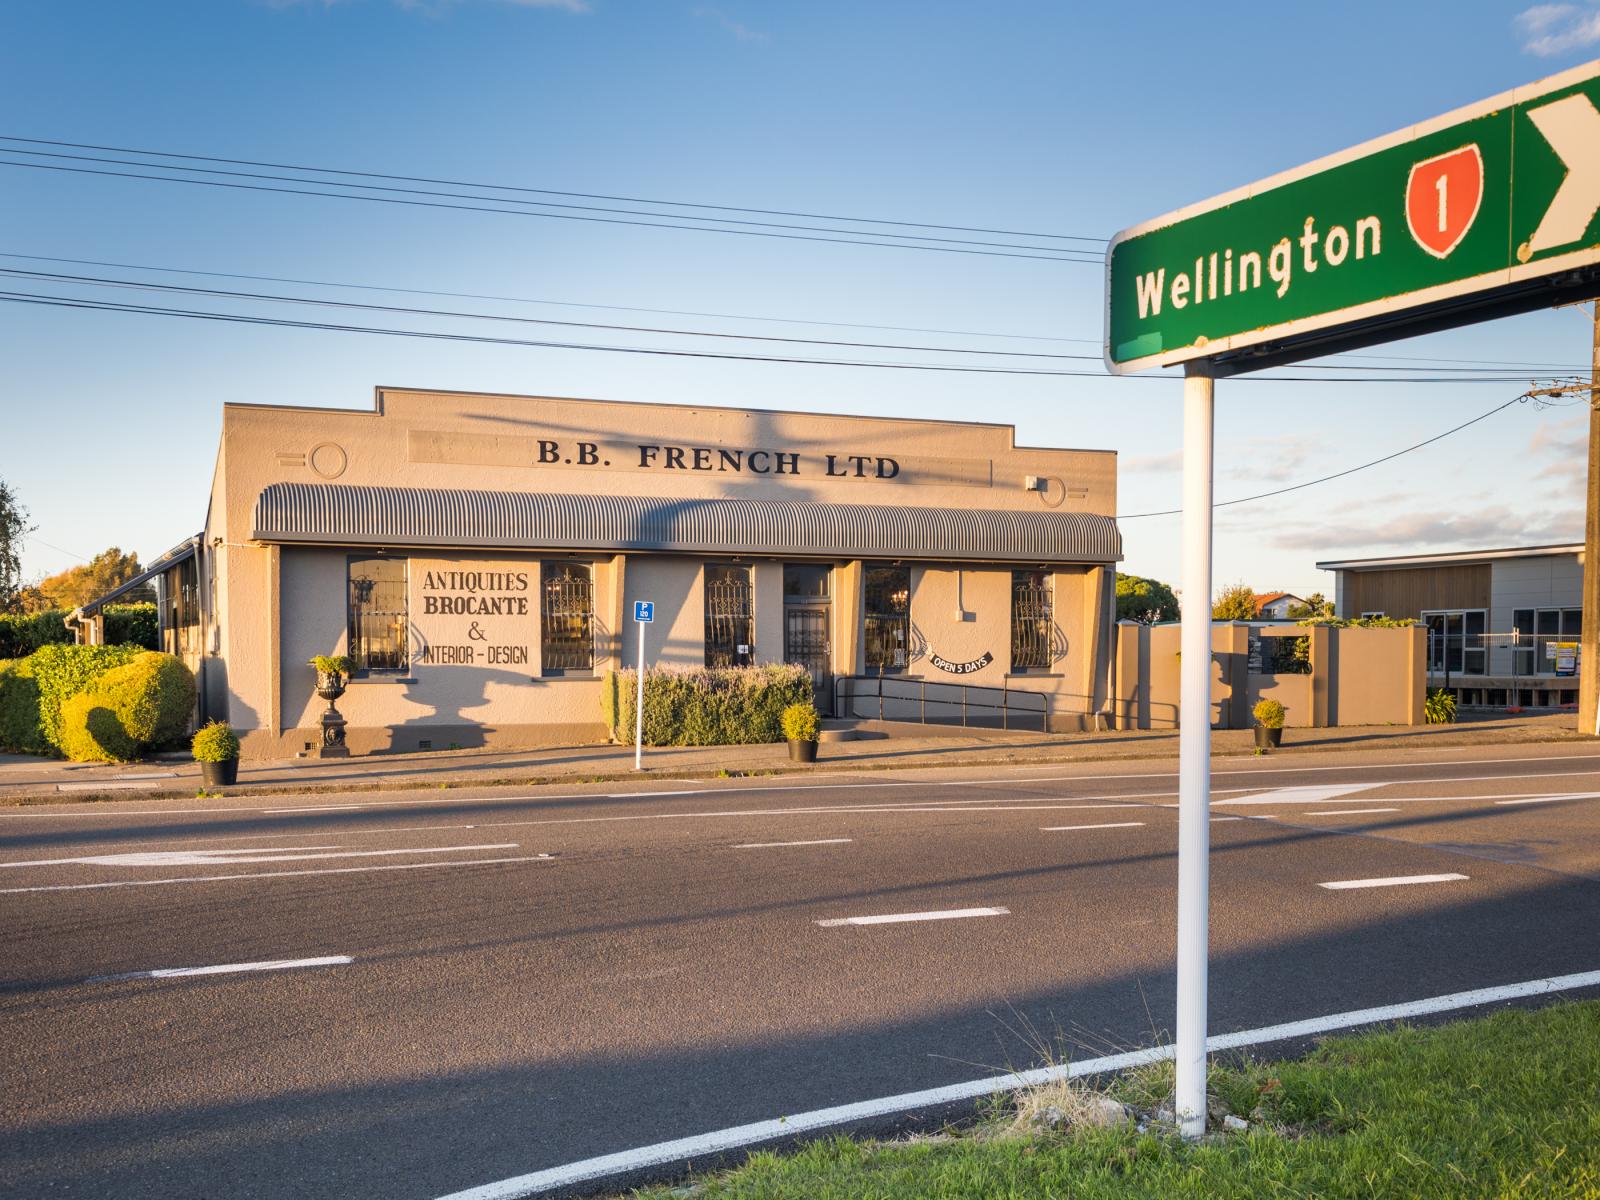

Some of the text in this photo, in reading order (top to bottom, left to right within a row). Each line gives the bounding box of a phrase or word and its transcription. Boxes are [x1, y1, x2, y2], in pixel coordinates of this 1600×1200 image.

[1435, 174, 1448, 233] 1
[1136, 216, 1381, 319] Wellington
[537, 440, 900, 479] B.B. FRENCH LTD
[423, 596, 529, 616] BROCANTE
[468, 621, 488, 642] &
[423, 645, 474, 665] INTERIOR
[487, 645, 529, 665] DESIGN
[934, 657, 987, 672] OPEN 5 DAYS
